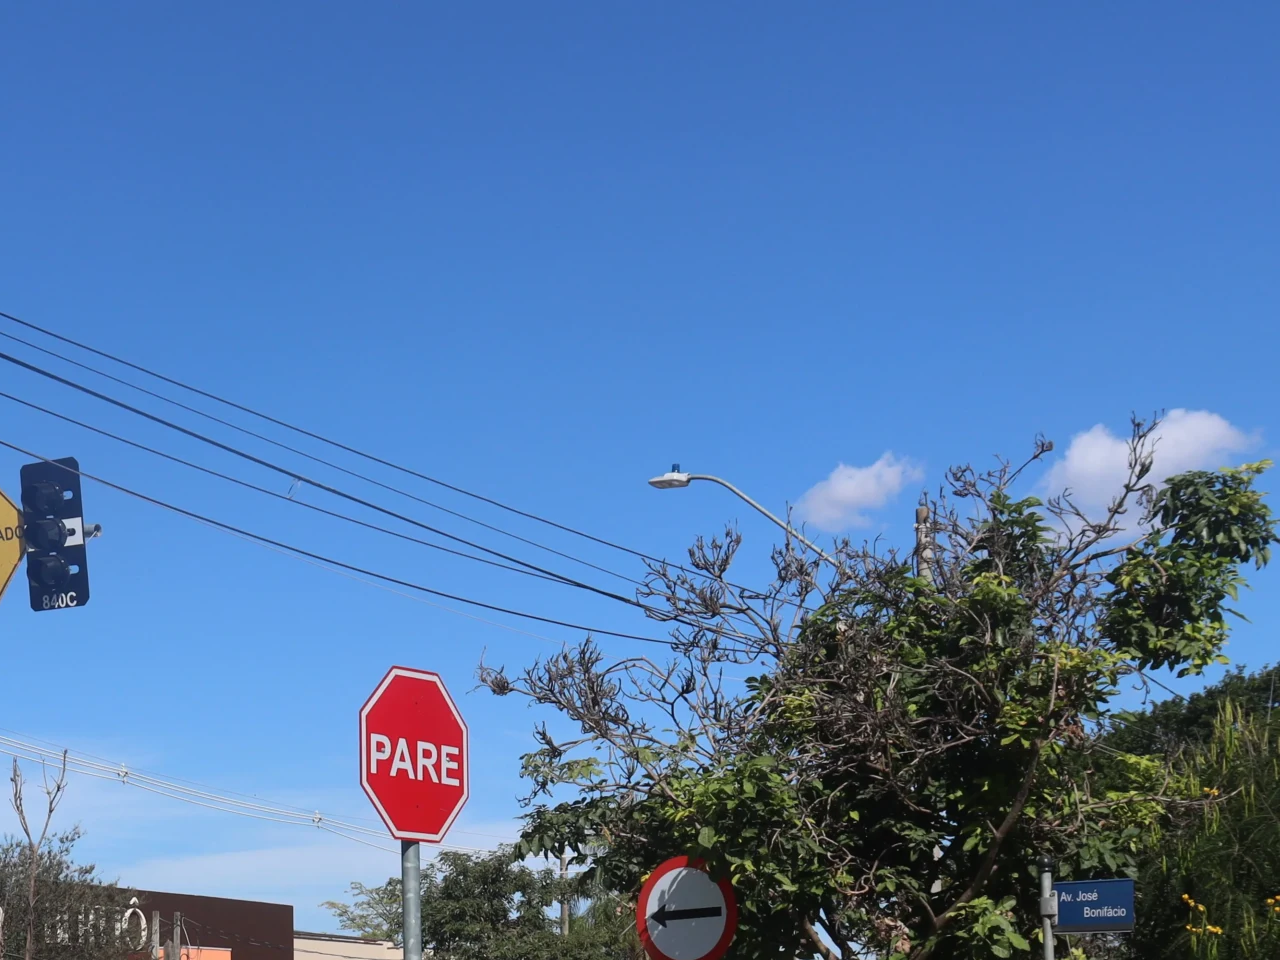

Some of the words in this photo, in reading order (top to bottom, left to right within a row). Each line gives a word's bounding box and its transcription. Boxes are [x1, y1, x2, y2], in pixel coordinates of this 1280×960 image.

[42, 591, 78, 609] 840C
[370, 732, 461, 787] PARE
[1060, 891, 1074, 902] Av.
[1076, 889, 1098, 902] José
[1083, 906, 1127, 918] Bonifácio
